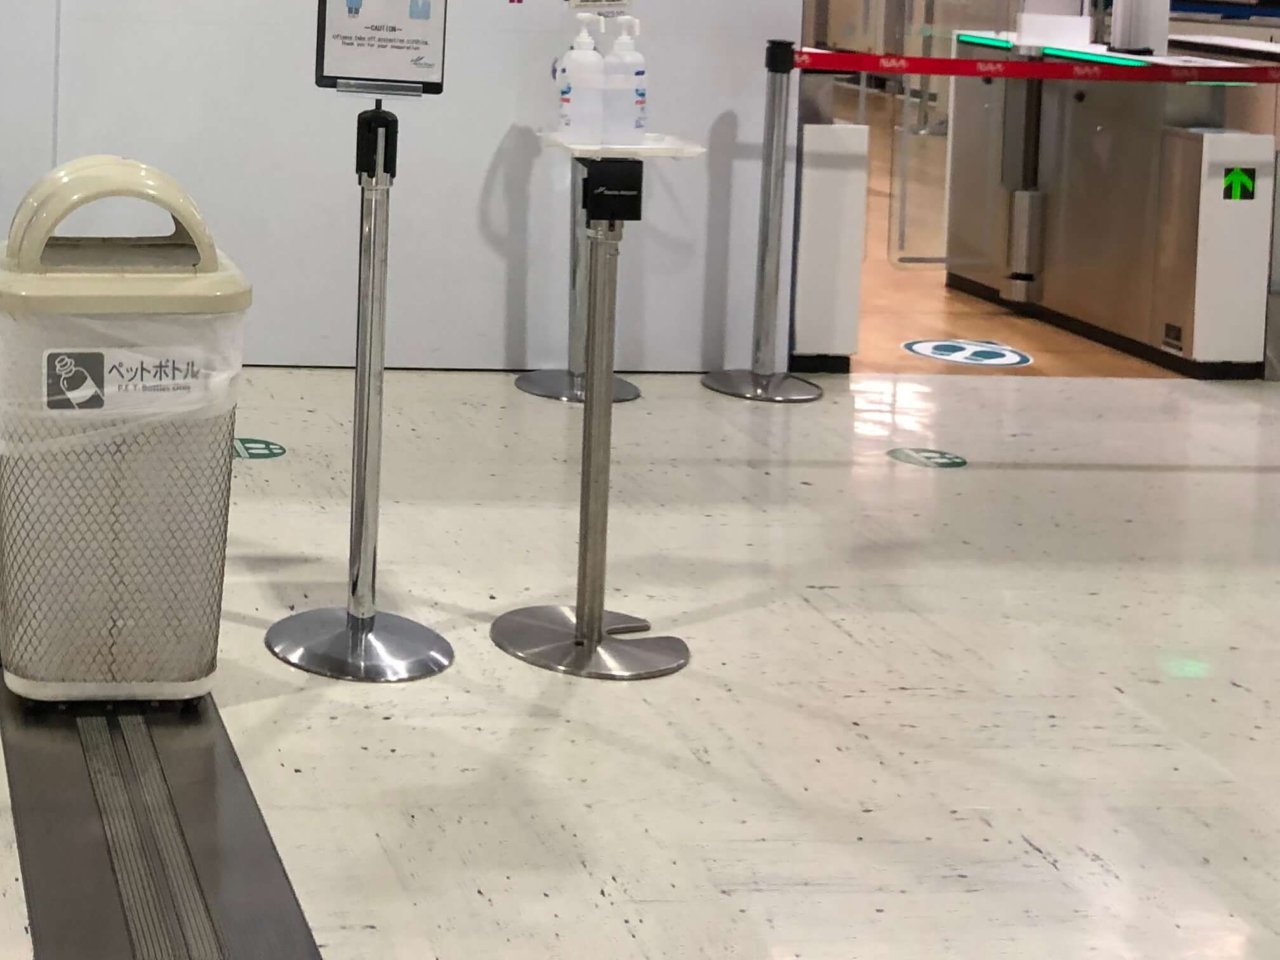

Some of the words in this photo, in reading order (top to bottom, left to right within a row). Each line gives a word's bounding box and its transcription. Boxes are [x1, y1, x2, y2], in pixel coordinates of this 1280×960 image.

[108, 358, 200, 382] ペットボトル
